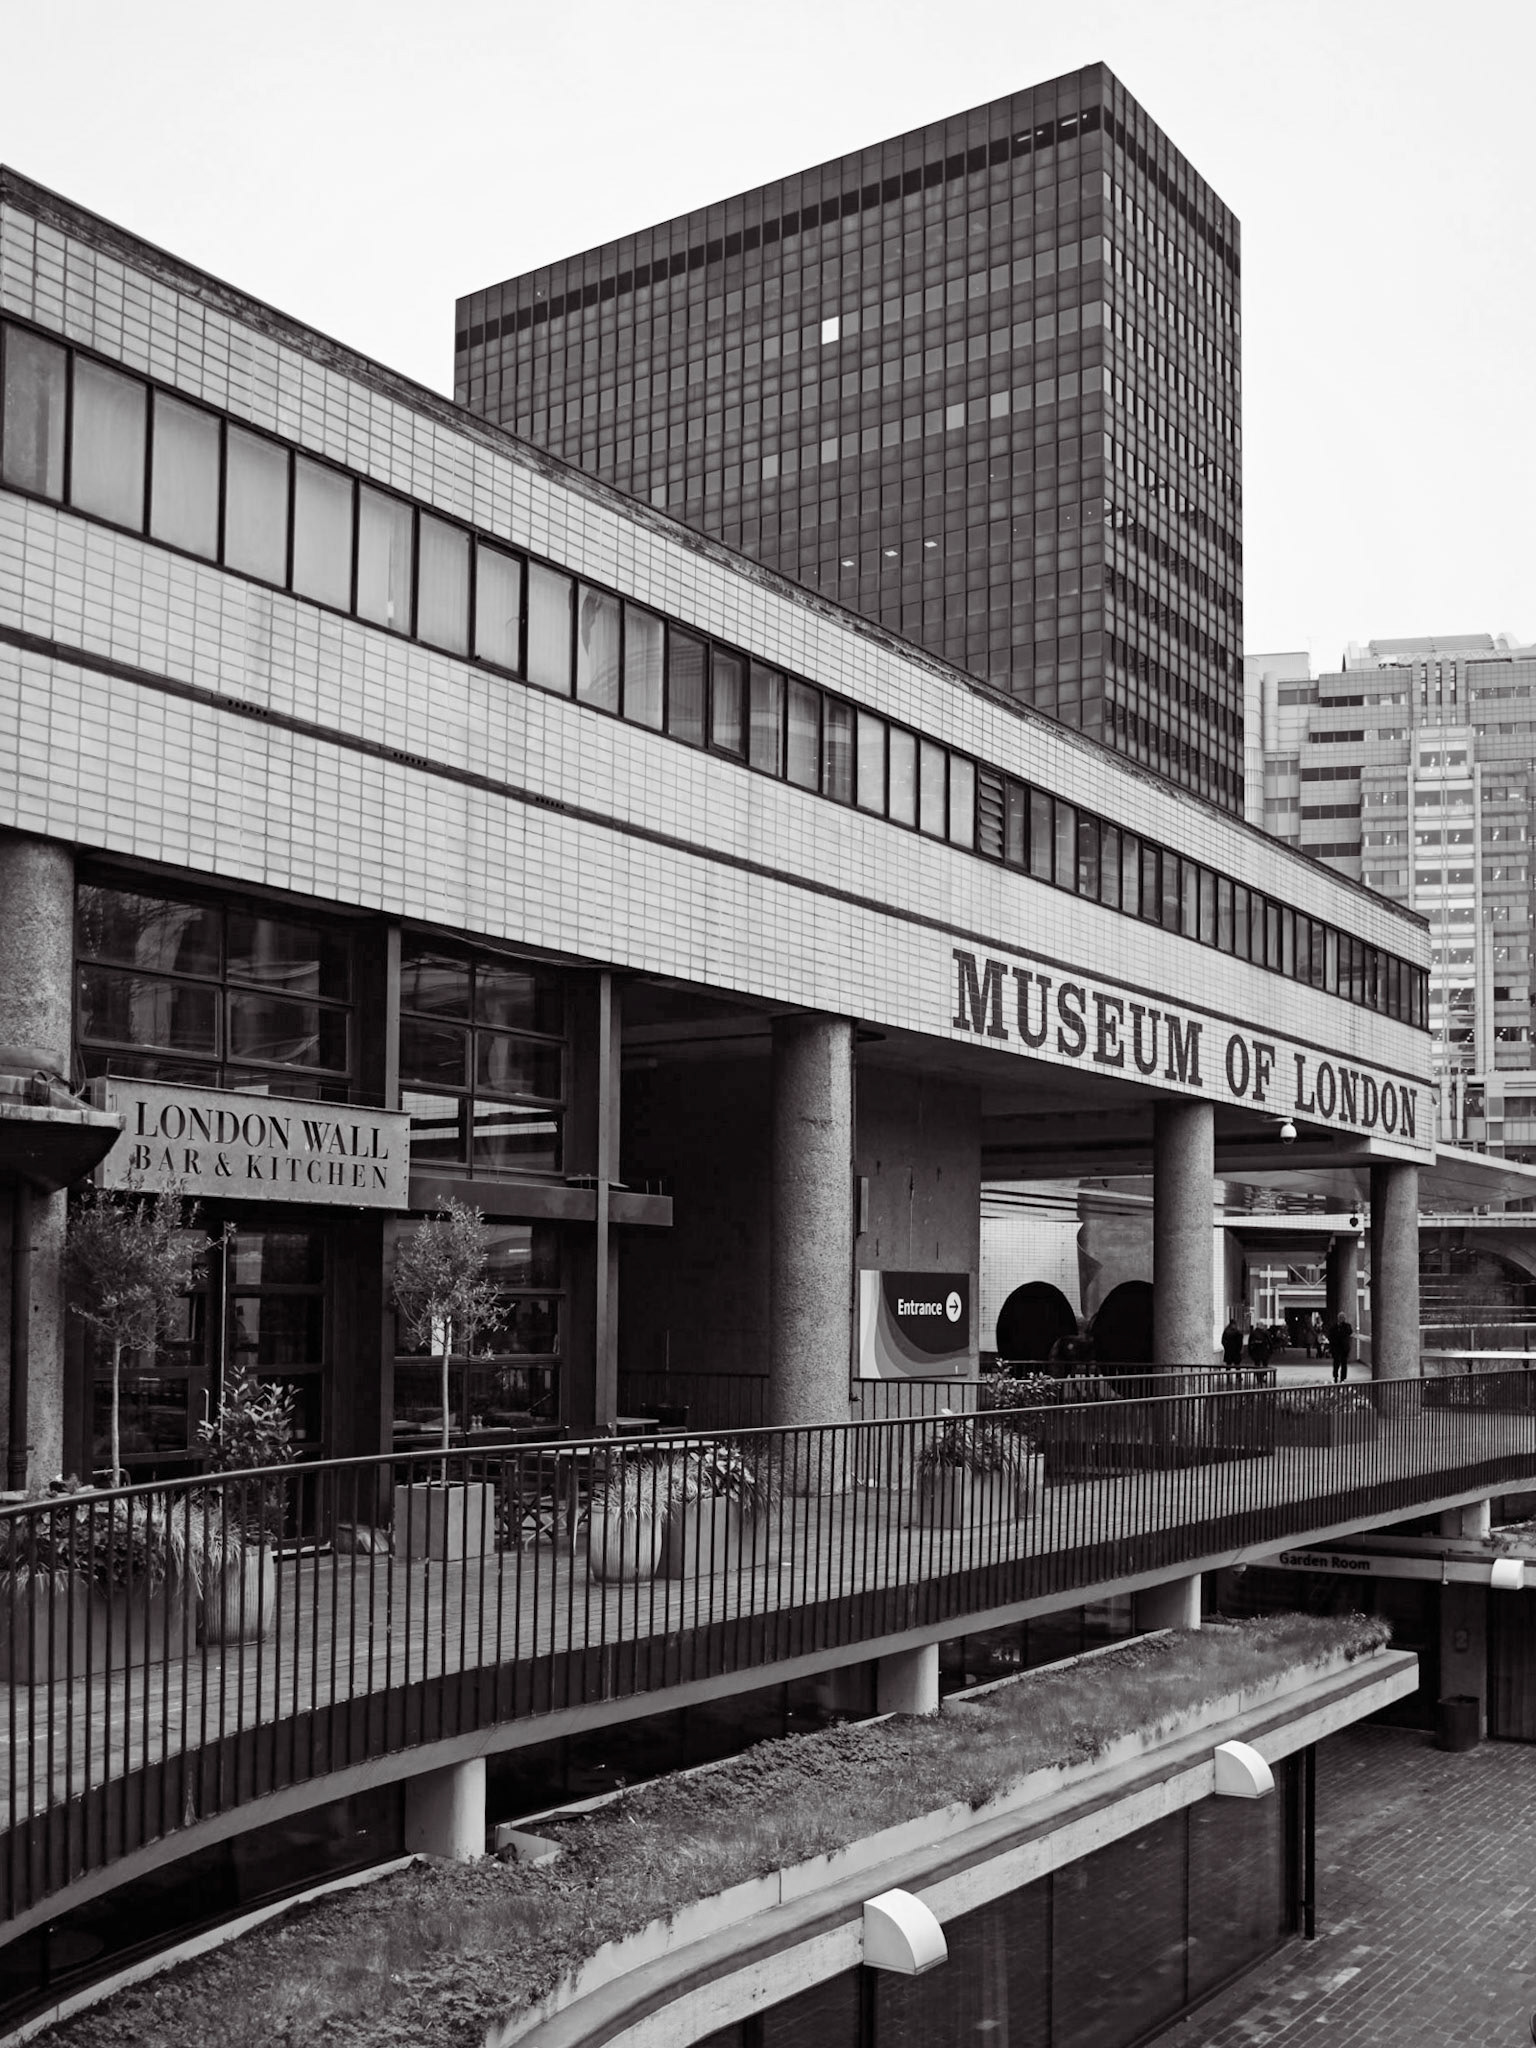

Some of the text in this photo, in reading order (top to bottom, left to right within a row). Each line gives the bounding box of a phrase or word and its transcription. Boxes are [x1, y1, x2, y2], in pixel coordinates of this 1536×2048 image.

[952, 948, 1418, 1139] MUSEUM OF LONDON
[134, 1101, 389, 1160] LONDON WALL
[134, 1143, 388, 1189] BAR & KITCHEN
[897, 1298, 943, 1316] Entrance
[1279, 1552, 1370, 1570] Garden Room
